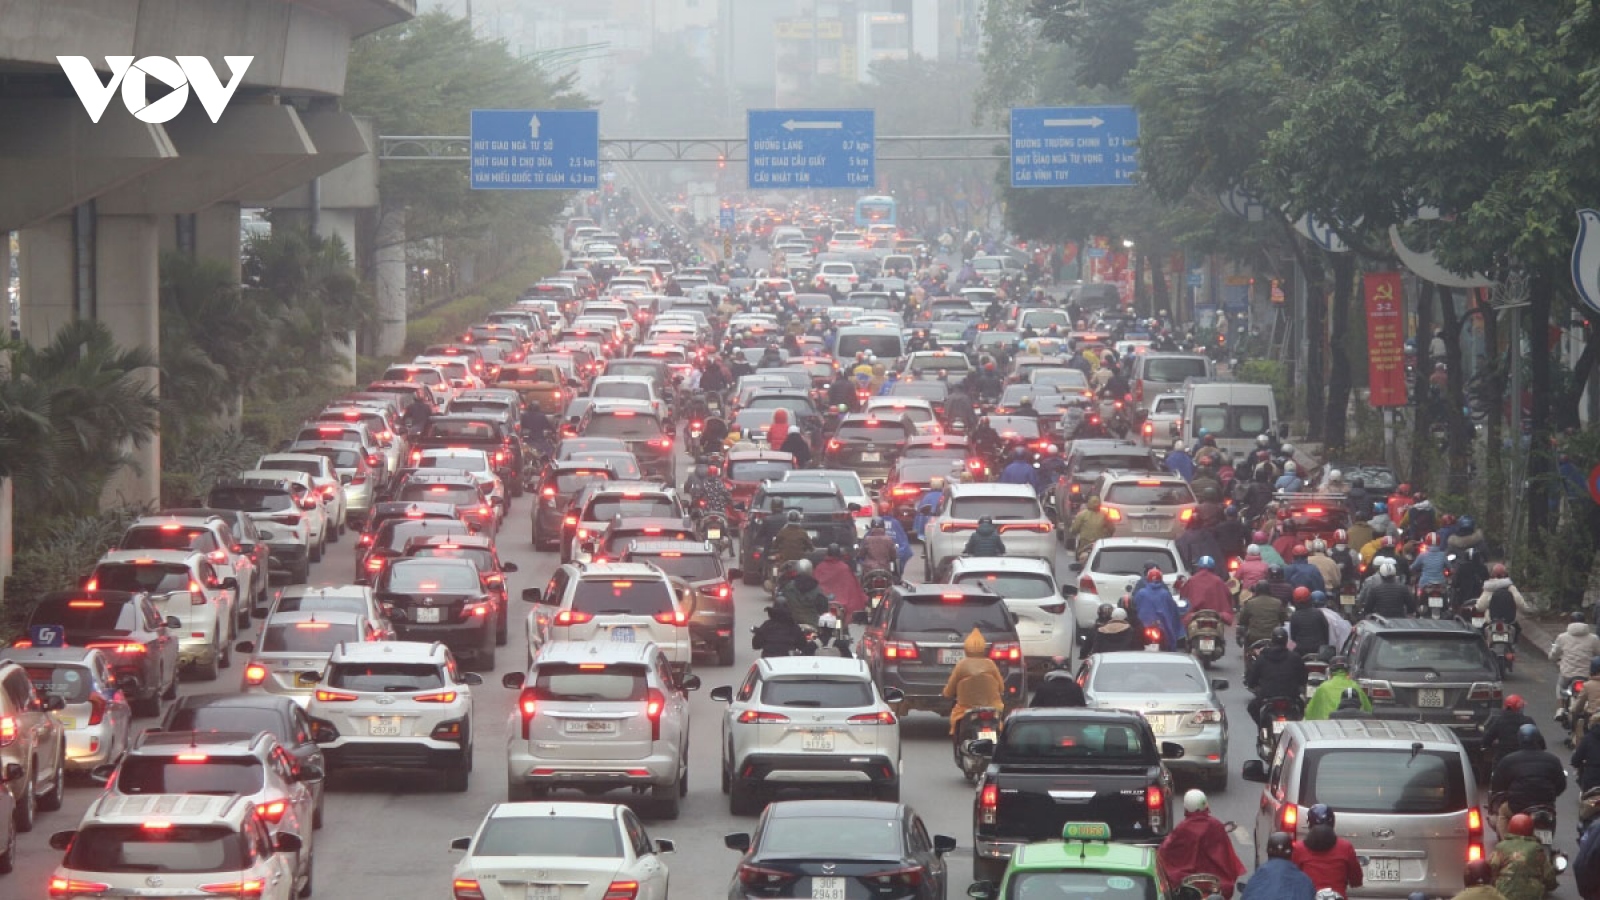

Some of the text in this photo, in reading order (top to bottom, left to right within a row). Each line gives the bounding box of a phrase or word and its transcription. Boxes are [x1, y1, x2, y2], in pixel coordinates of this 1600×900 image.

[474, 138, 489, 150] NÚT
[491, 140, 509, 150] GIAO
[754, 138, 781, 150] ĐƯỜNG
[782, 138, 803, 150] LÁNG
[856, 140, 869, 151] km
[1076, 138, 1101, 147] CHINH
[474, 155, 489, 166] NÚT
[491, 156, 509, 166] GIAO
[583, 157, 596, 167] km
[754, 154, 769, 166] NÚT
[771, 156, 789, 166] GIAO
[808, 152, 826, 166] GIẤY
[856, 156, 869, 166] km
[1032, 154, 1050, 165] GIAO
[1122, 154, 1135, 163] km
[475, 171, 490, 182] VĂN
[491, 170, 510, 182] MIẾU
[511, 170, 532, 182] QUỐC
[546, 170, 565, 182] GIÁM
[583, 173, 596, 183] km
[754, 170, 769, 182] CẦU
[795, 169, 810, 182] TÂN
[819, 877, 837, 889] 30F
[812, 888, 844, 899] 294.81
